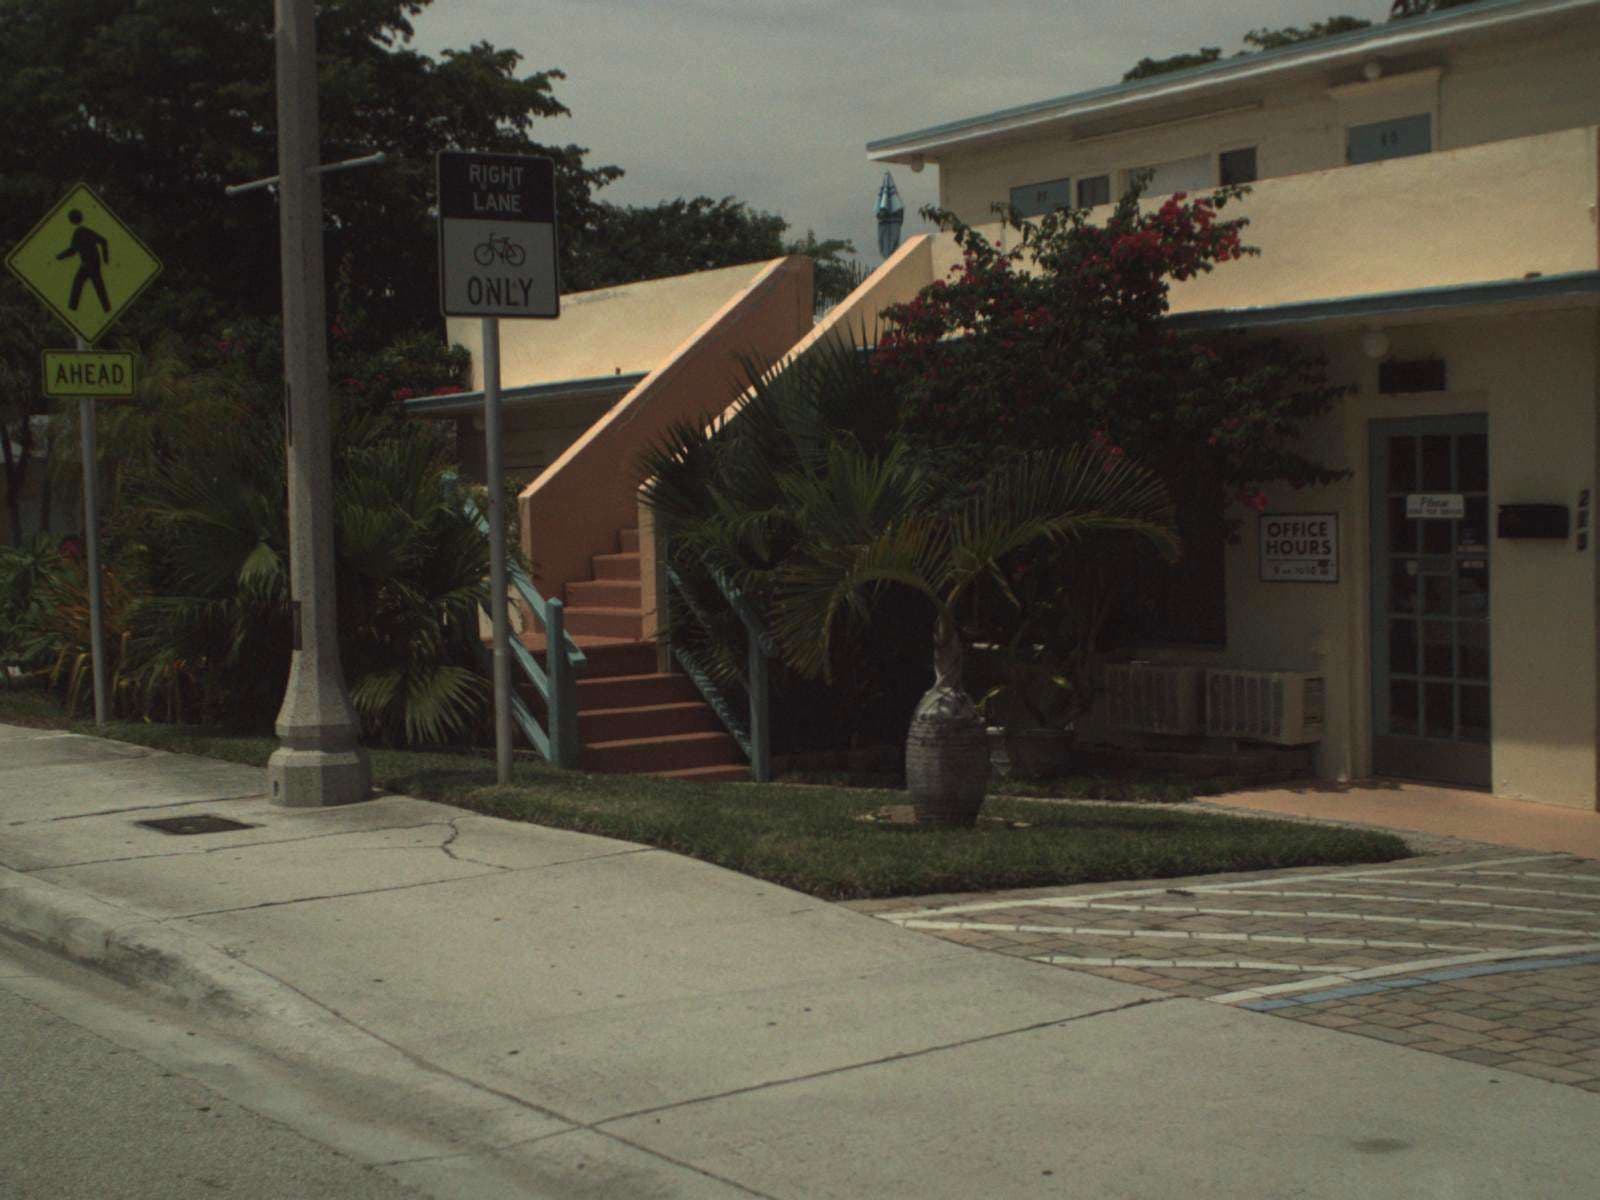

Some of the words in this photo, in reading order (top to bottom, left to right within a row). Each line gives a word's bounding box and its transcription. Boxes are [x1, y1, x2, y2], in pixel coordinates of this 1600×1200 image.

[469, 164, 524, 186] RIGHT
[473, 192, 522, 212] LANE
[468, 276, 533, 306] ONLY
[56, 363, 124, 384] AHEAD
[1267, 522, 1327, 537] OFFICE
[1266, 540, 1331, 555] HOURS
